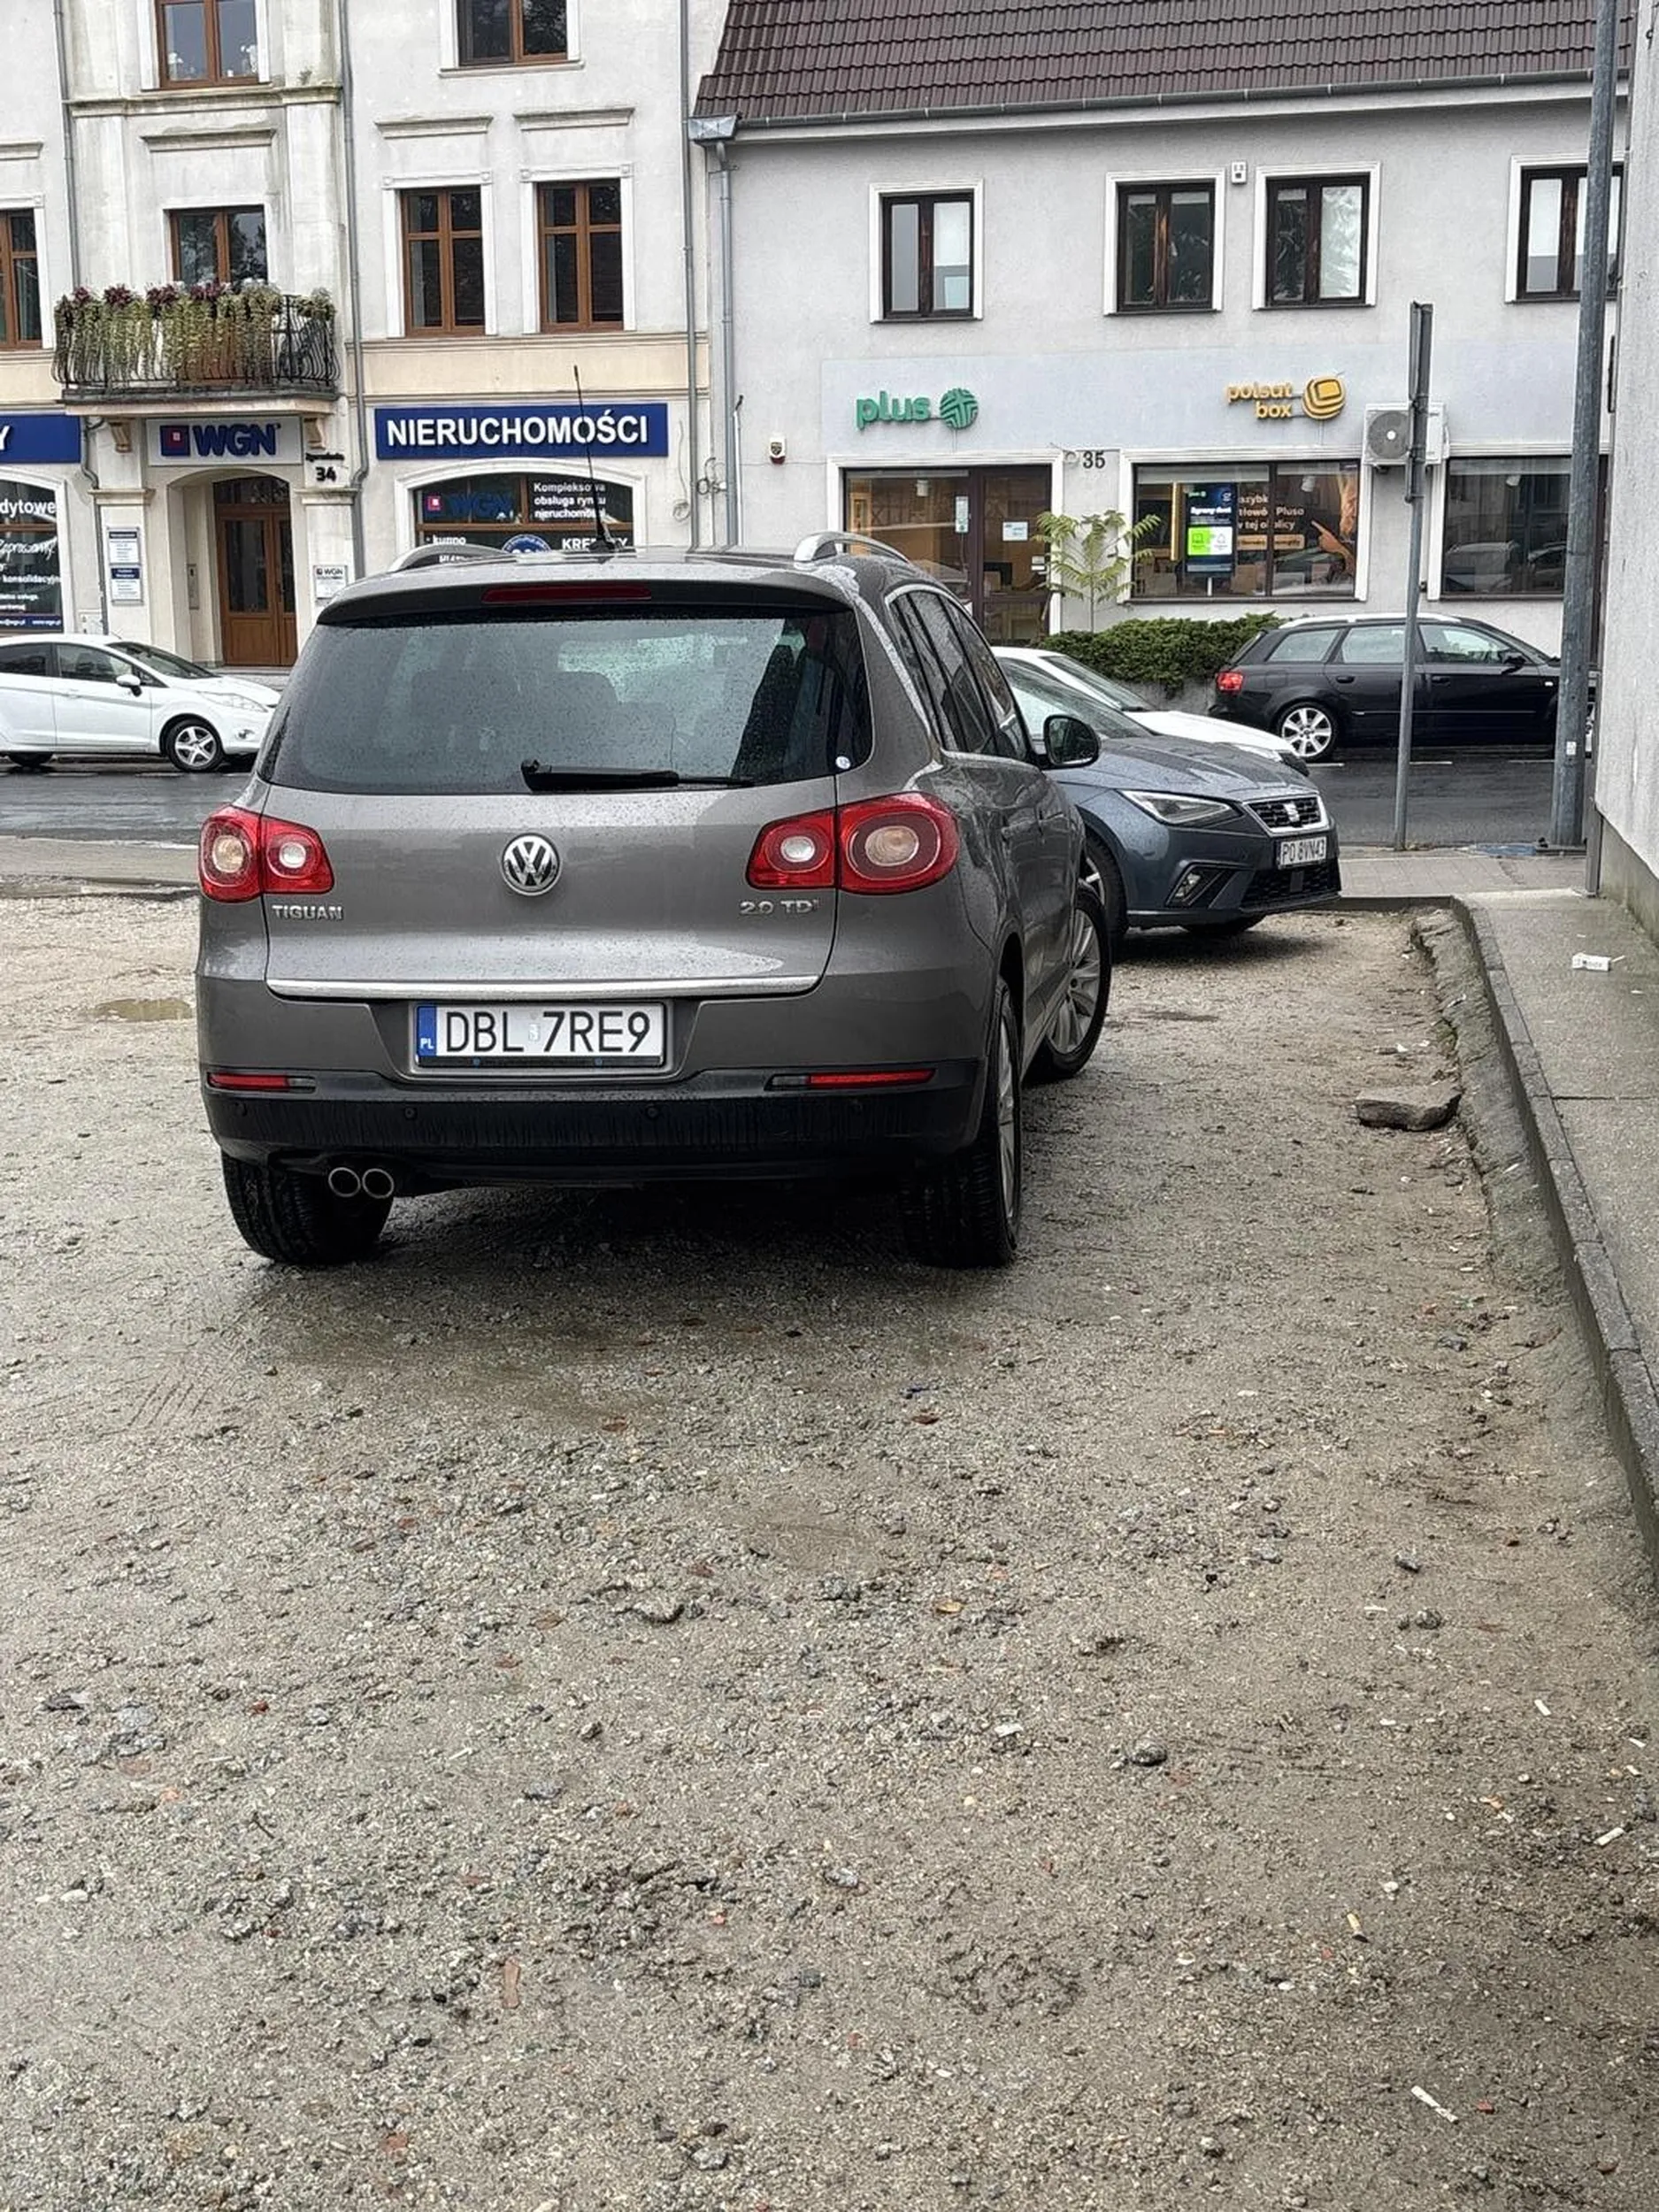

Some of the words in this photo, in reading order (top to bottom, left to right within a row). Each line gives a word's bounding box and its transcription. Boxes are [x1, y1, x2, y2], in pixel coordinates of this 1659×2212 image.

[1225, 381, 1293, 404] polsat
[856, 390, 931, 431] plus
[1256, 401, 1293, 419] box
[387, 410, 648, 445] NIERUCHOMOŚCI
[192, 423, 277, 457] WGN
[1082, 450, 1106, 469] 35
[315, 466, 336, 481] 34
[271, 904, 343, 920] TIGUAN
[446, 1011, 524, 1052] DBL
[543, 1011, 650, 1053] 7RE9
[420, 1038, 434, 1050] PL
